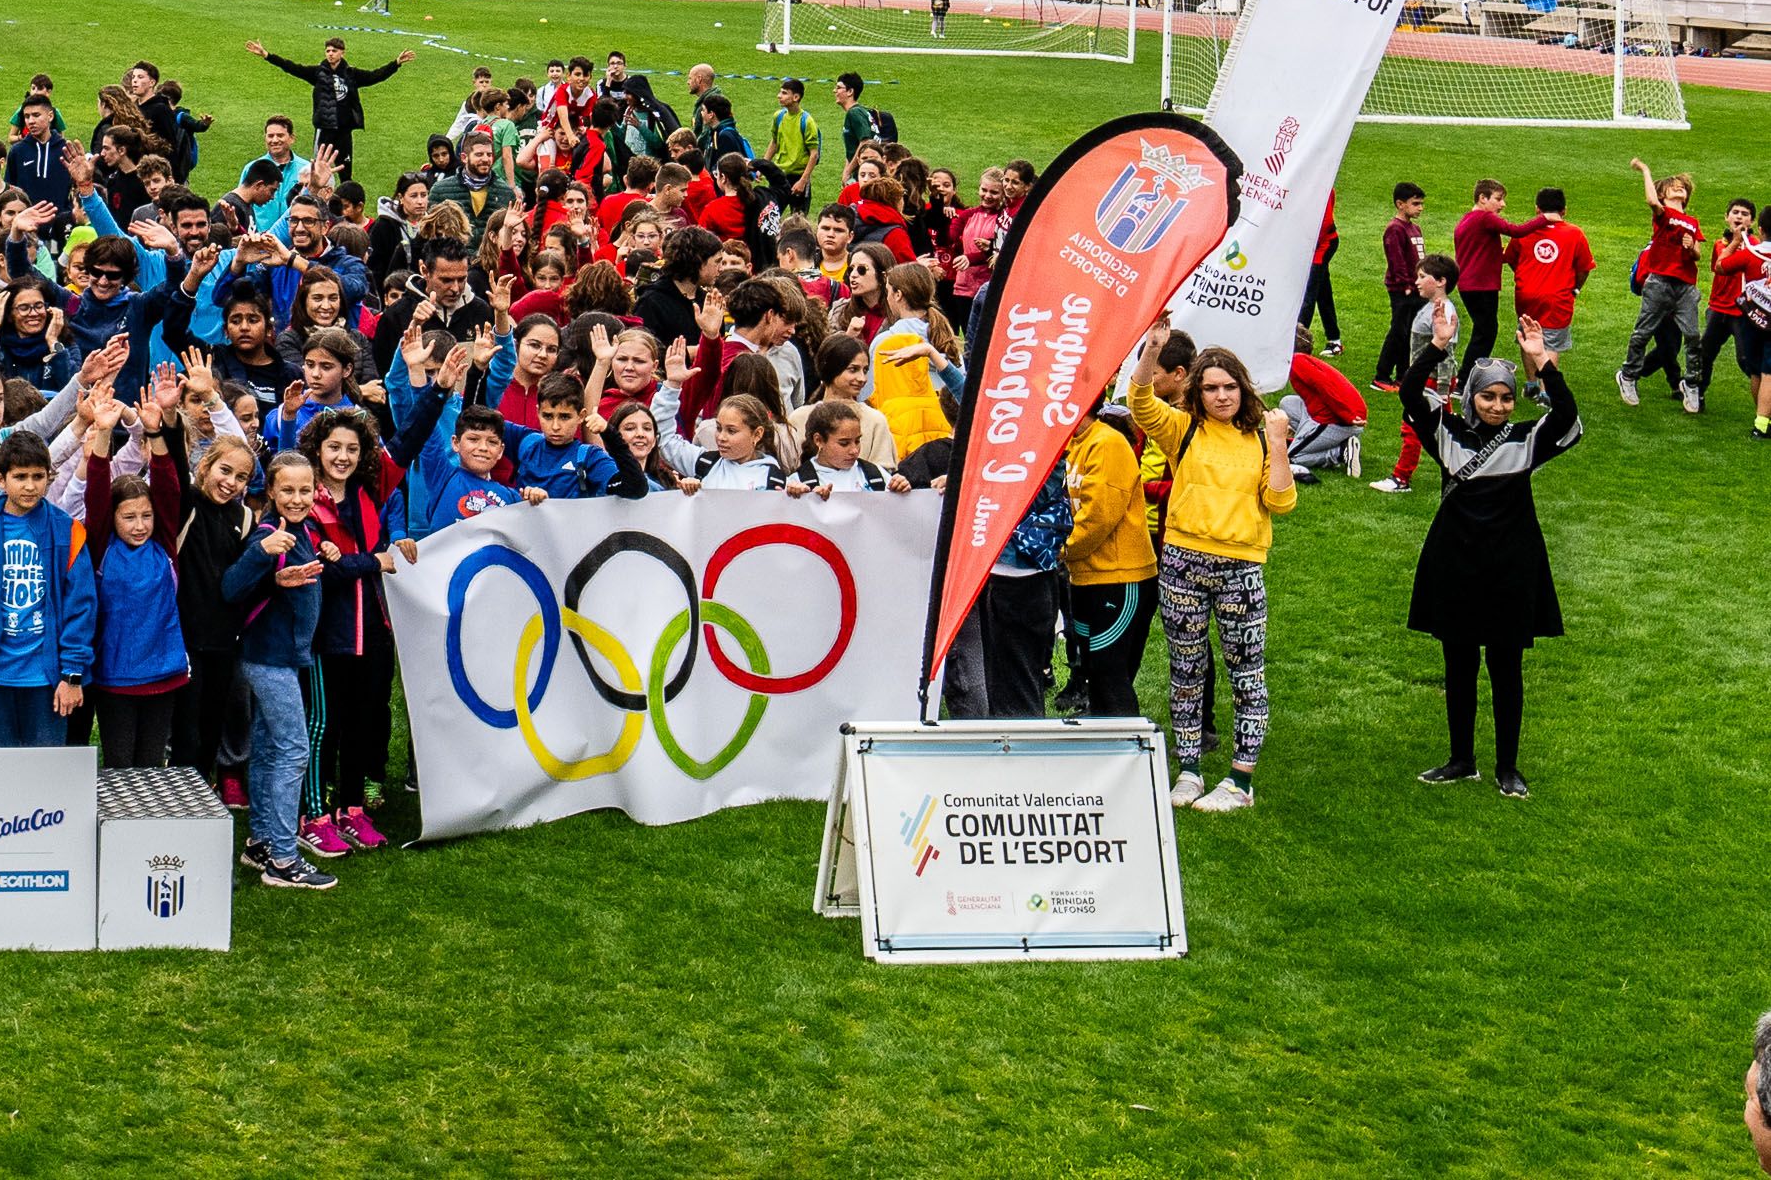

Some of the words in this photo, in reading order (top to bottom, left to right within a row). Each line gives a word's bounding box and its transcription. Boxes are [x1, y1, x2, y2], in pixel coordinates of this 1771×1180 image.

[943, 793, 1021, 809] Comunitat
[1024, 792, 1104, 808] Valenciana
[944, 812, 1105, 839] COMUNITAT
[958, 840, 995, 866] DE
[1001, 839, 1128, 866] L'ESPORT
[957, 895, 1002, 903] GENERALITAT
[1050, 897, 1095, 906] TRINIDAD
[1052, 906, 1096, 915] ALFONSO
